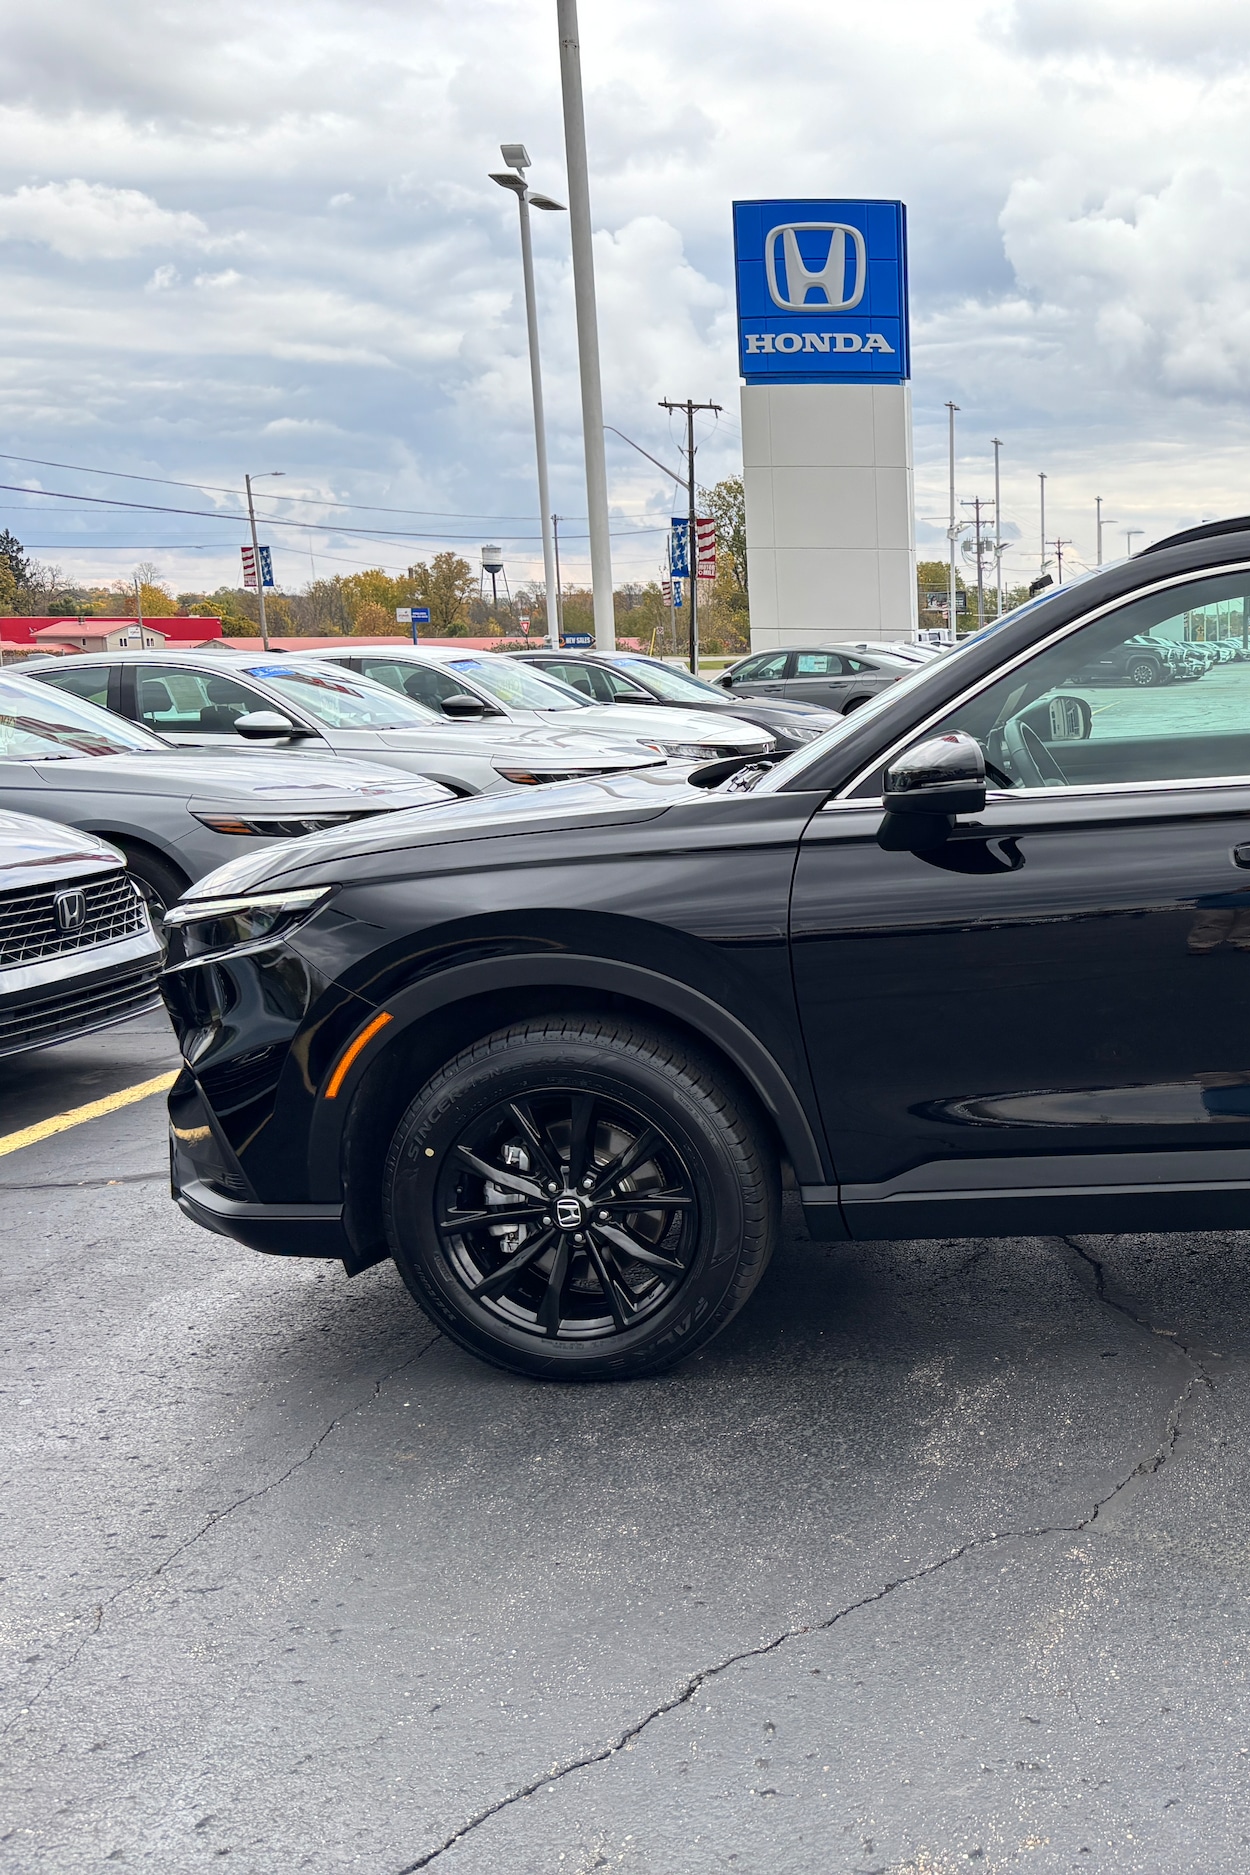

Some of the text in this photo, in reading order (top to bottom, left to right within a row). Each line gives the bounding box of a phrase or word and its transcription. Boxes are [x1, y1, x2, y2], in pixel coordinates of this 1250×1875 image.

[744, 332, 896, 354] HONDA
[565, 636, 591, 645] NEW SALES
